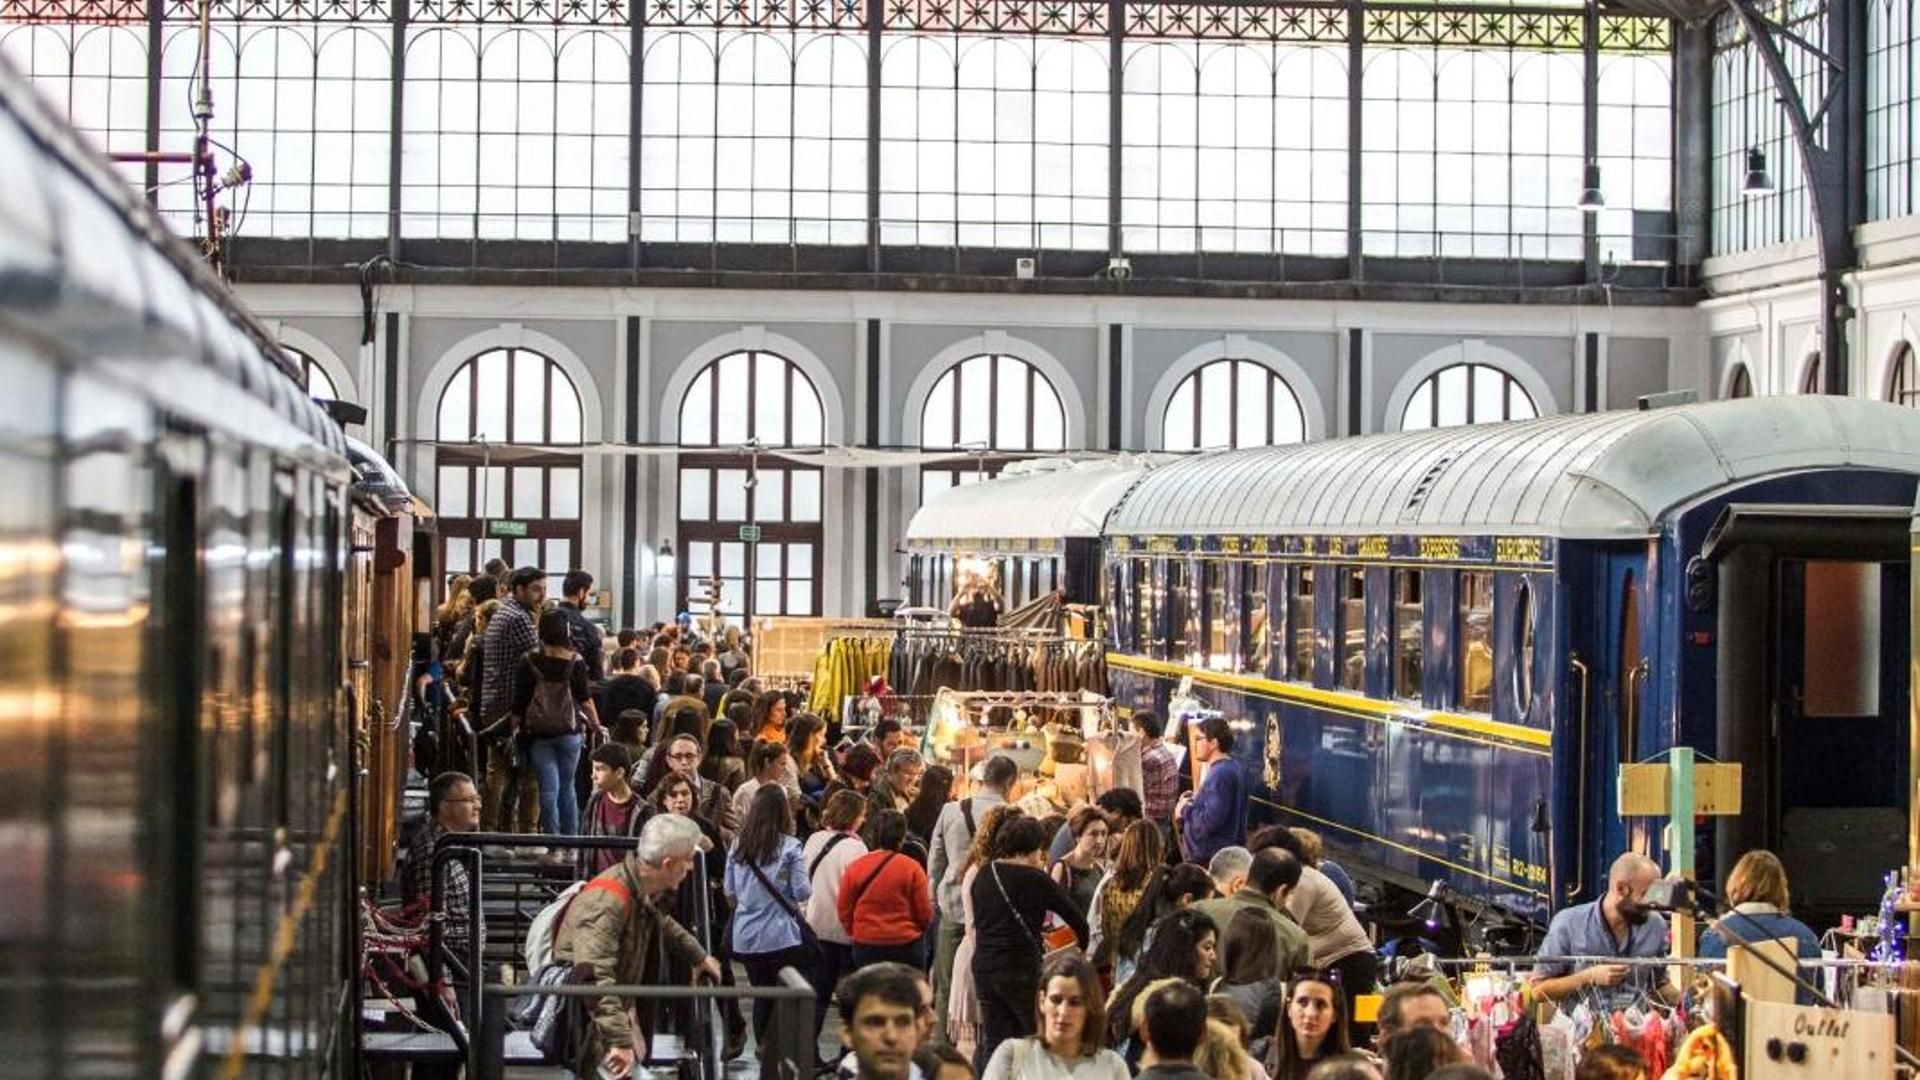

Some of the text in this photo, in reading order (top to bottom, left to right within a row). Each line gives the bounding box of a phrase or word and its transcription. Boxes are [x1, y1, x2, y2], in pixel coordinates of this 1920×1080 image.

[1421, 537, 1460, 560] EXPRESOS
[1496, 538, 1541, 561] EUROPEOS
[1794, 1012, 1850, 1039] Outlet
